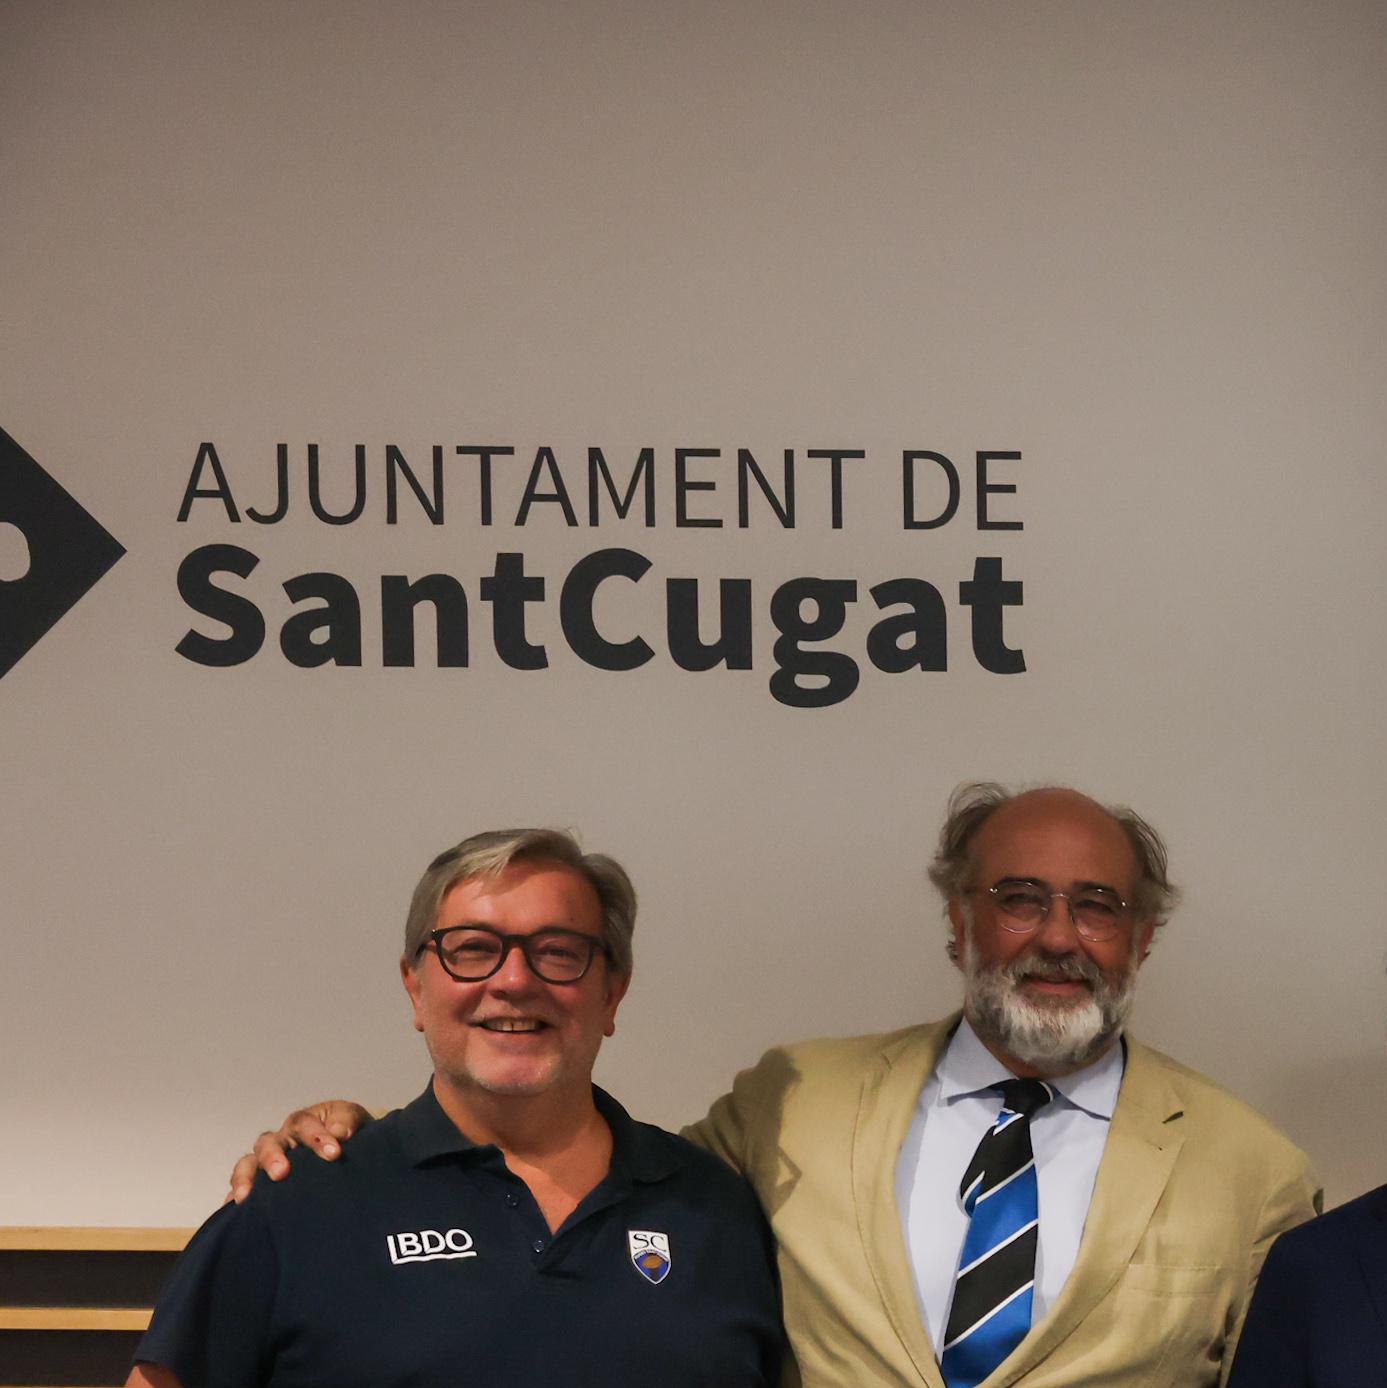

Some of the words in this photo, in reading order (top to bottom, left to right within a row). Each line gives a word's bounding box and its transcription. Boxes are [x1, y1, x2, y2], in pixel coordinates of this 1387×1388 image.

[176, 441, 866, 531] AJUNTAMENT
[902, 448, 1025, 532] DE
[174, 543, 1027, 708] SantCugat
[396, 1228, 474, 1257] BDO
[633, 1233, 667, 1252] SC
